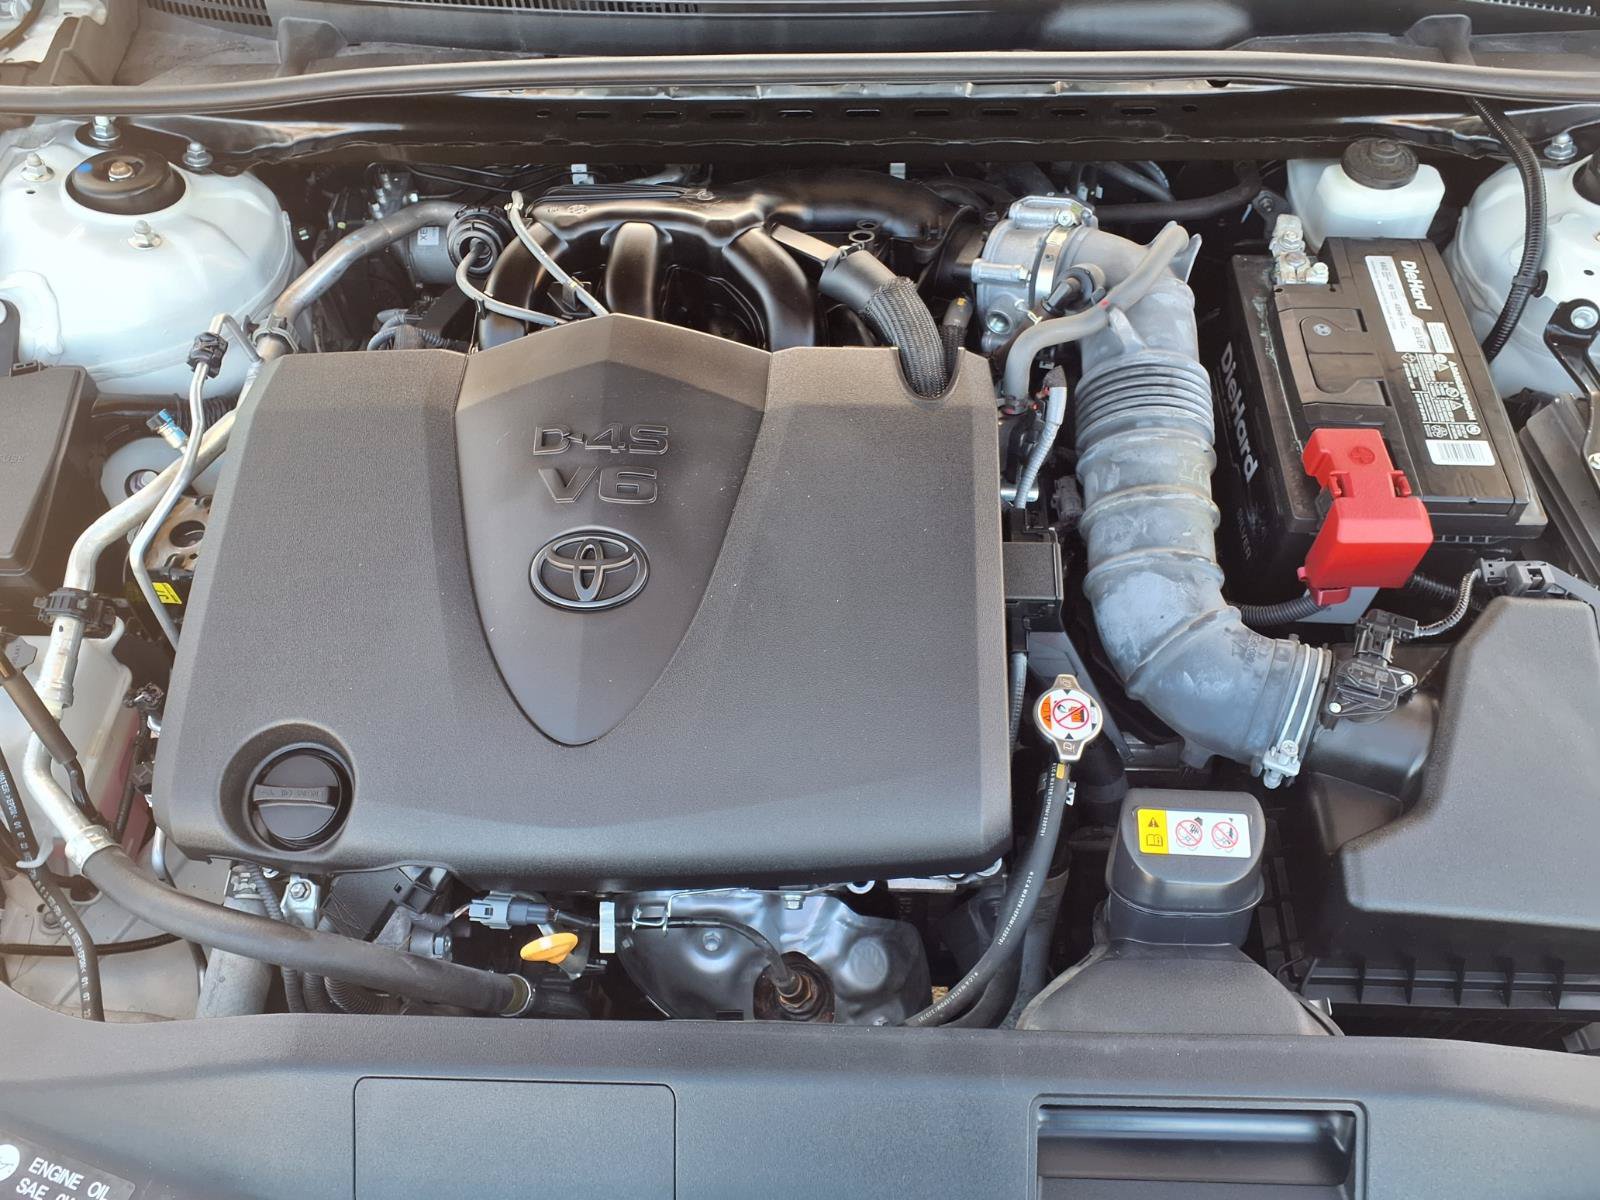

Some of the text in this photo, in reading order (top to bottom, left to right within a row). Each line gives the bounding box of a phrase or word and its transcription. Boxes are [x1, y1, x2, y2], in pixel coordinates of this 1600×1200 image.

[1400, 260, 1432, 310] DieHard
[1412, 326, 1426, 350] SILVER
[1220, 342, 1259, 483] DieHard
[533, 422, 670, 456] D-4S
[538, 464, 659, 505] V6
[1236, 507, 1251, 560] SILVER
[15, 1177, 50, 1200] SAE
[28, 1156, 111, 1200] ENGINE OIL
